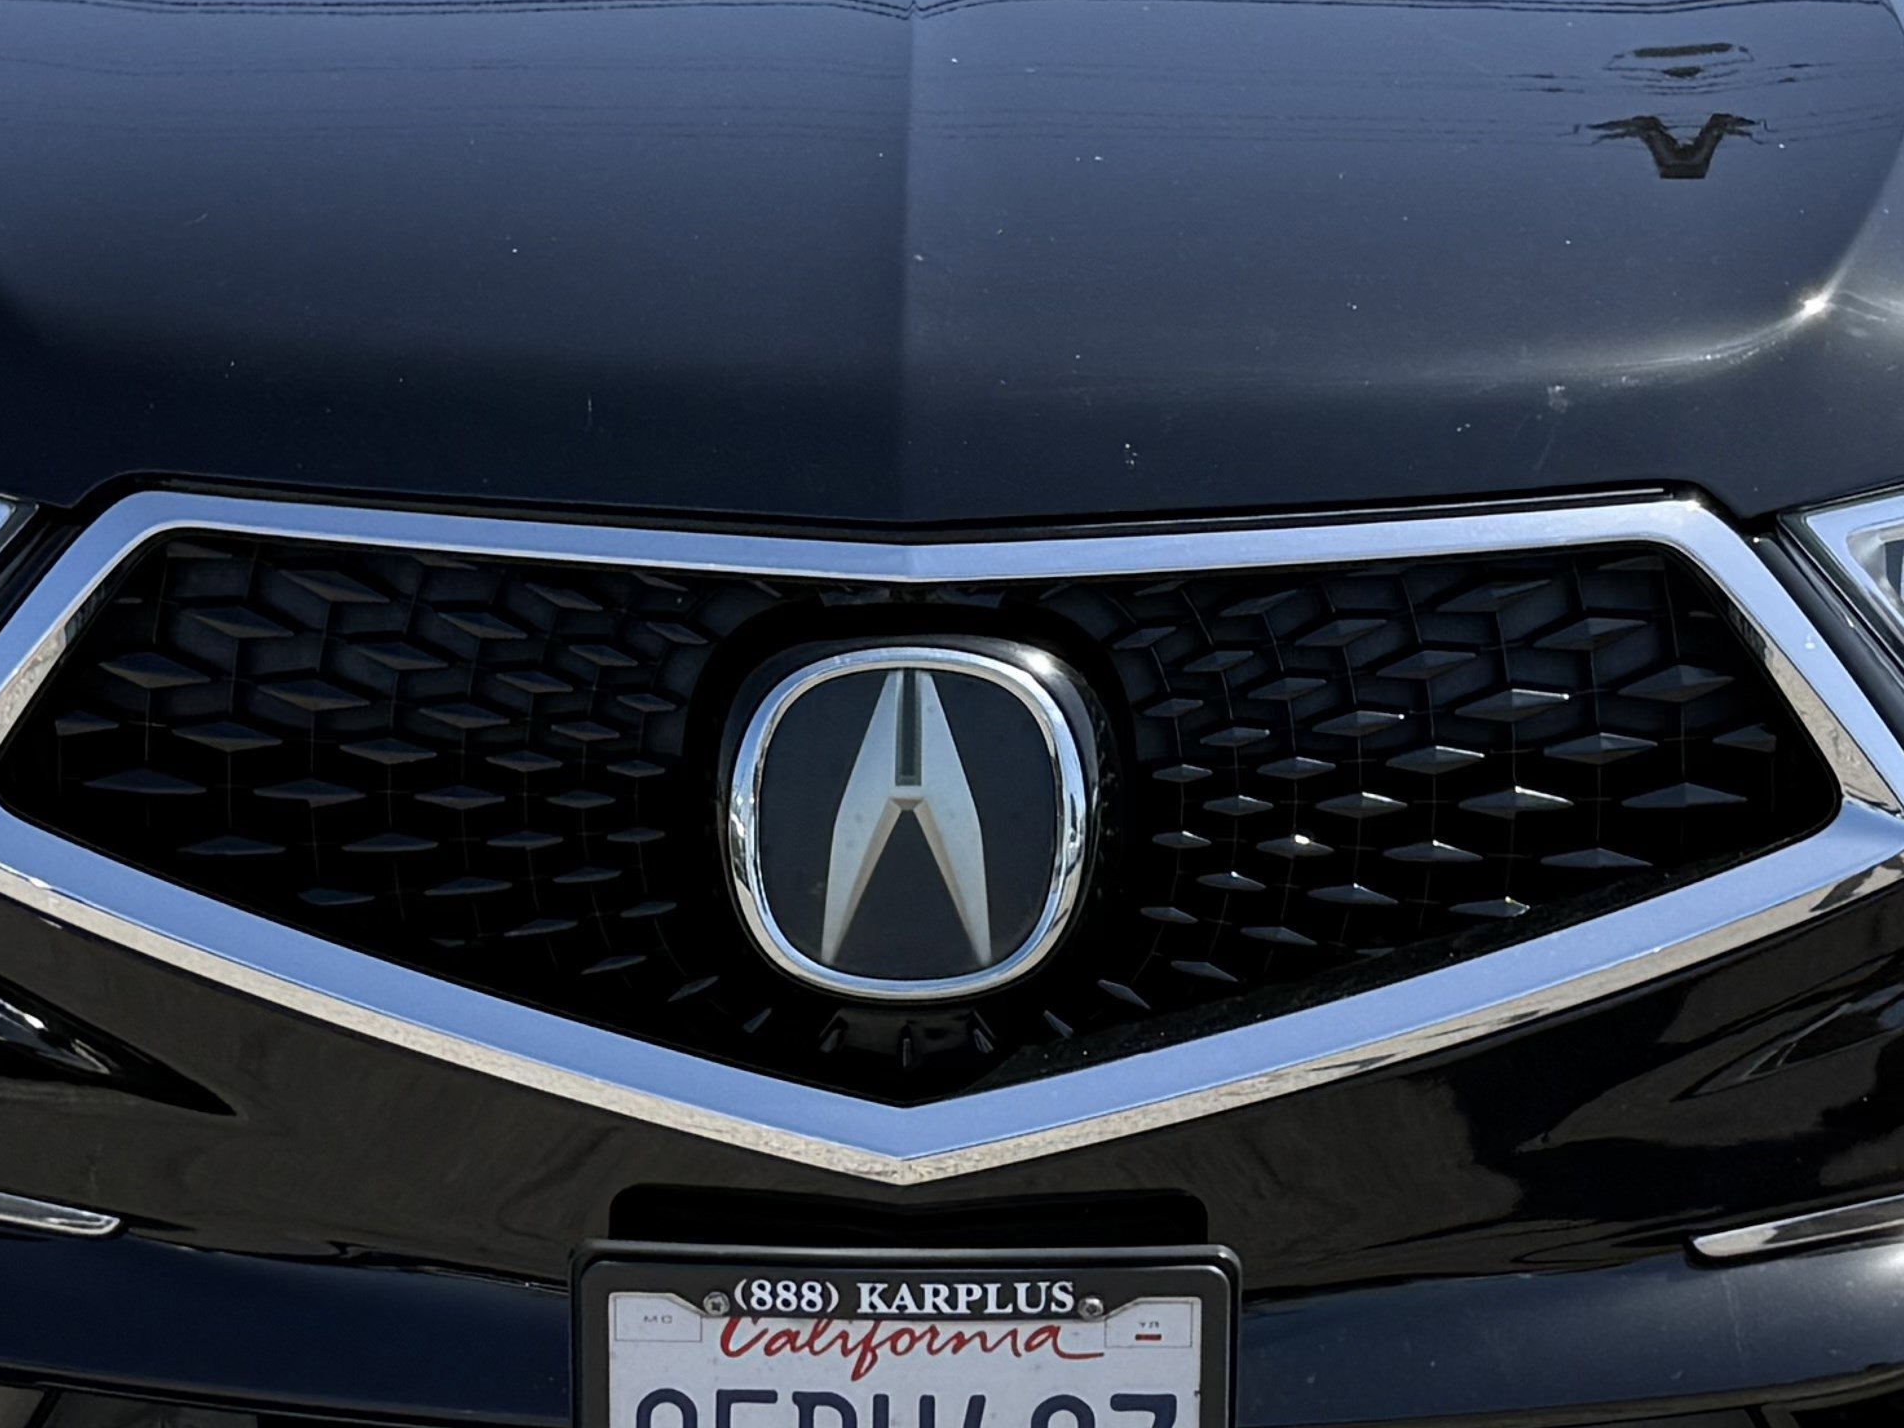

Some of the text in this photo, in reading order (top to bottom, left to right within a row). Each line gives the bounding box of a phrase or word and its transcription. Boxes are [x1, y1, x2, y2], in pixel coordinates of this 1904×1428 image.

[734, 1278, 1075, 1315] (888) KARPLUS
[720, 1318, 1104, 1381] California
